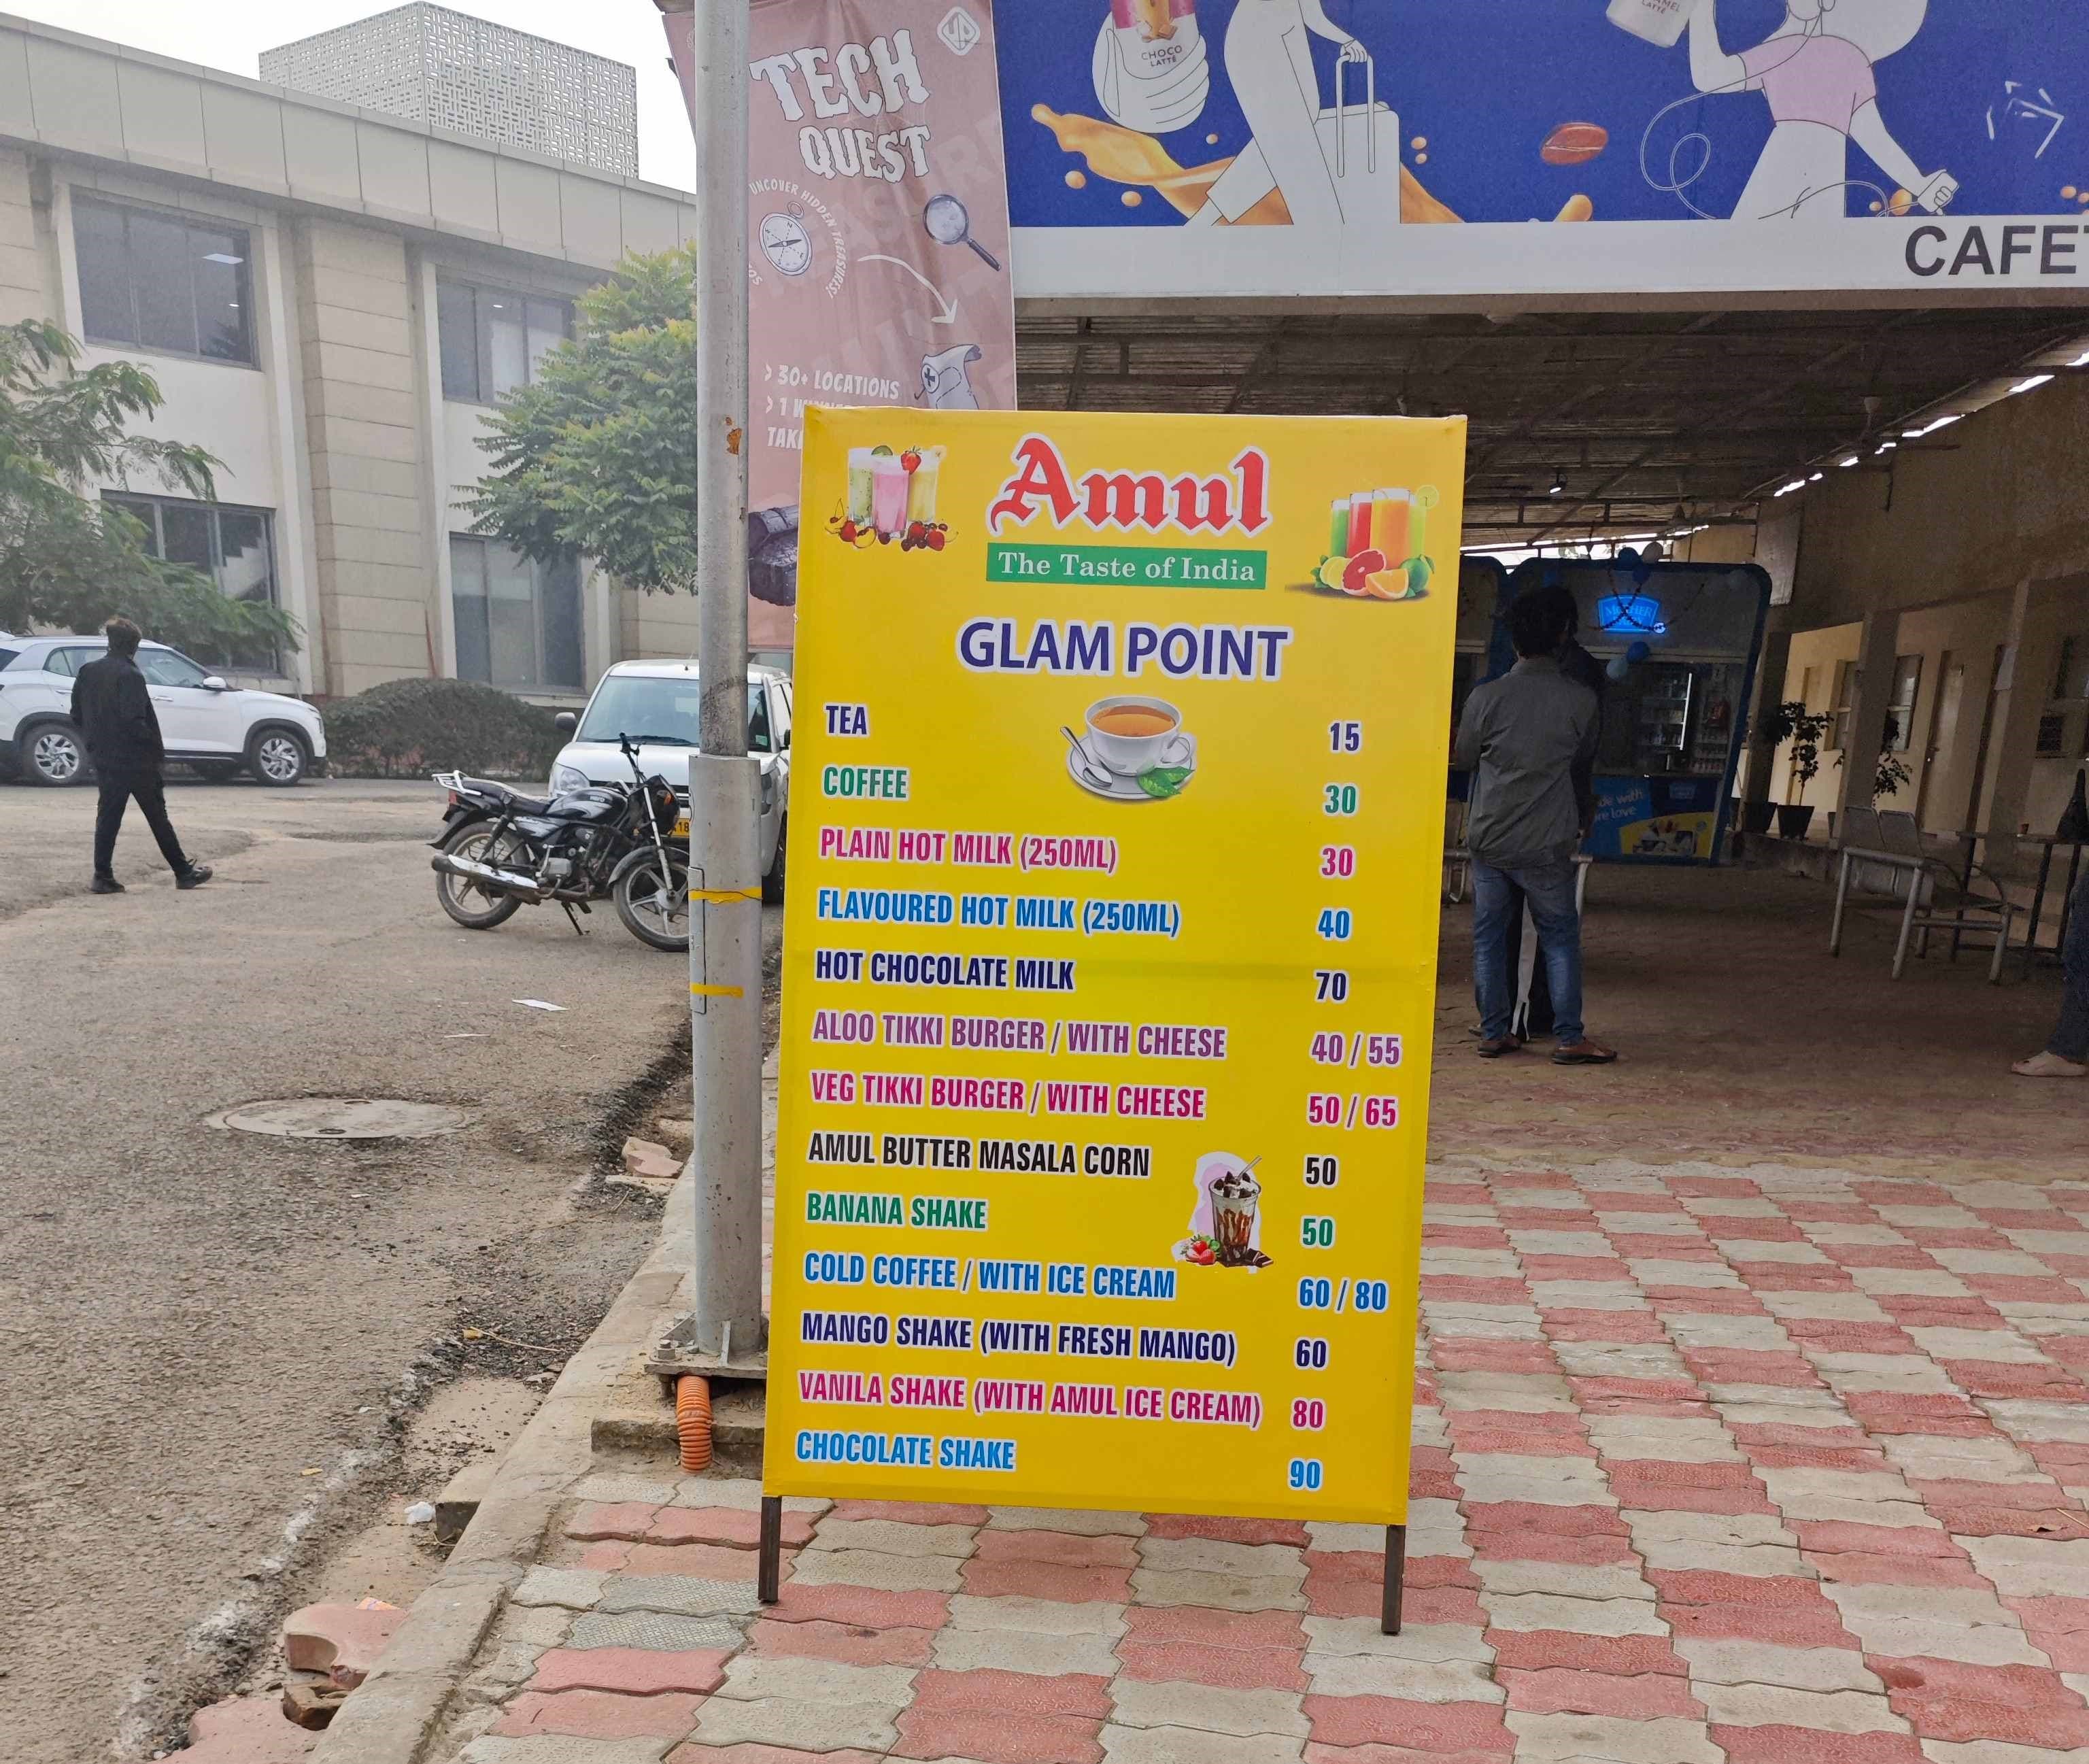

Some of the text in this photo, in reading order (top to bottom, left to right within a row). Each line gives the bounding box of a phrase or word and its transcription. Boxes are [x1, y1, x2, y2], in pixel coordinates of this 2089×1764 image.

[749, 29, 930, 122] TECH
[1141, 45, 1182, 60] CHOCO
[798, 124, 931, 184] QUEST
[749, 178, 849, 299] UNCOVER HIDDEN TREASURES!
[1905, 225, 2089, 276] CAFE
[777, 364, 900, 400] 30+ LOCATIONS
[767, 426, 802, 450] TAK
[991, 437, 1268, 532] Amul
[998, 552, 1256, 581] The Taste of India
[959, 622, 1289, 677] GLAM POINT
[826, 705, 1360, 751] TEA 15
[823, 766, 1356, 814] COFFEE 30
[821, 828, 1353, 877] PLAIN HOT MILK (250ML) 30
[818, 889, 1350, 938] FLAVOURED HOT MILK (250ML) 40
[816, 951, 1347, 1001] HOT CHOCOLATE MILK 70
[813, 1011, 1399, 1066] ALOO TIKKI BURGER / WITH CHEESE 40 / 55
[811, 1072, 1397, 1129] VEG TIKKI BURGER / WITH CHEESE 50 / 65
[809, 1132, 1337, 1186] AMUL BUTTER MASALA CORN 50
[807, 1193, 1333, 1247] BANANA SHAKE 50
[805, 1253, 1387, 1312] COLD COFFEE / WITH ICE CREAM 60 / 80
[802, 1313, 1327, 1368] MANGO SHAKE (WITH FRESH MANGO) 60
[800, 1372, 1323, 1429] VANILA SHAKE (WITH AMUL ICE CREAM) 80
[797, 1431, 1321, 1489] CHOCOLATE SHAKE 90
